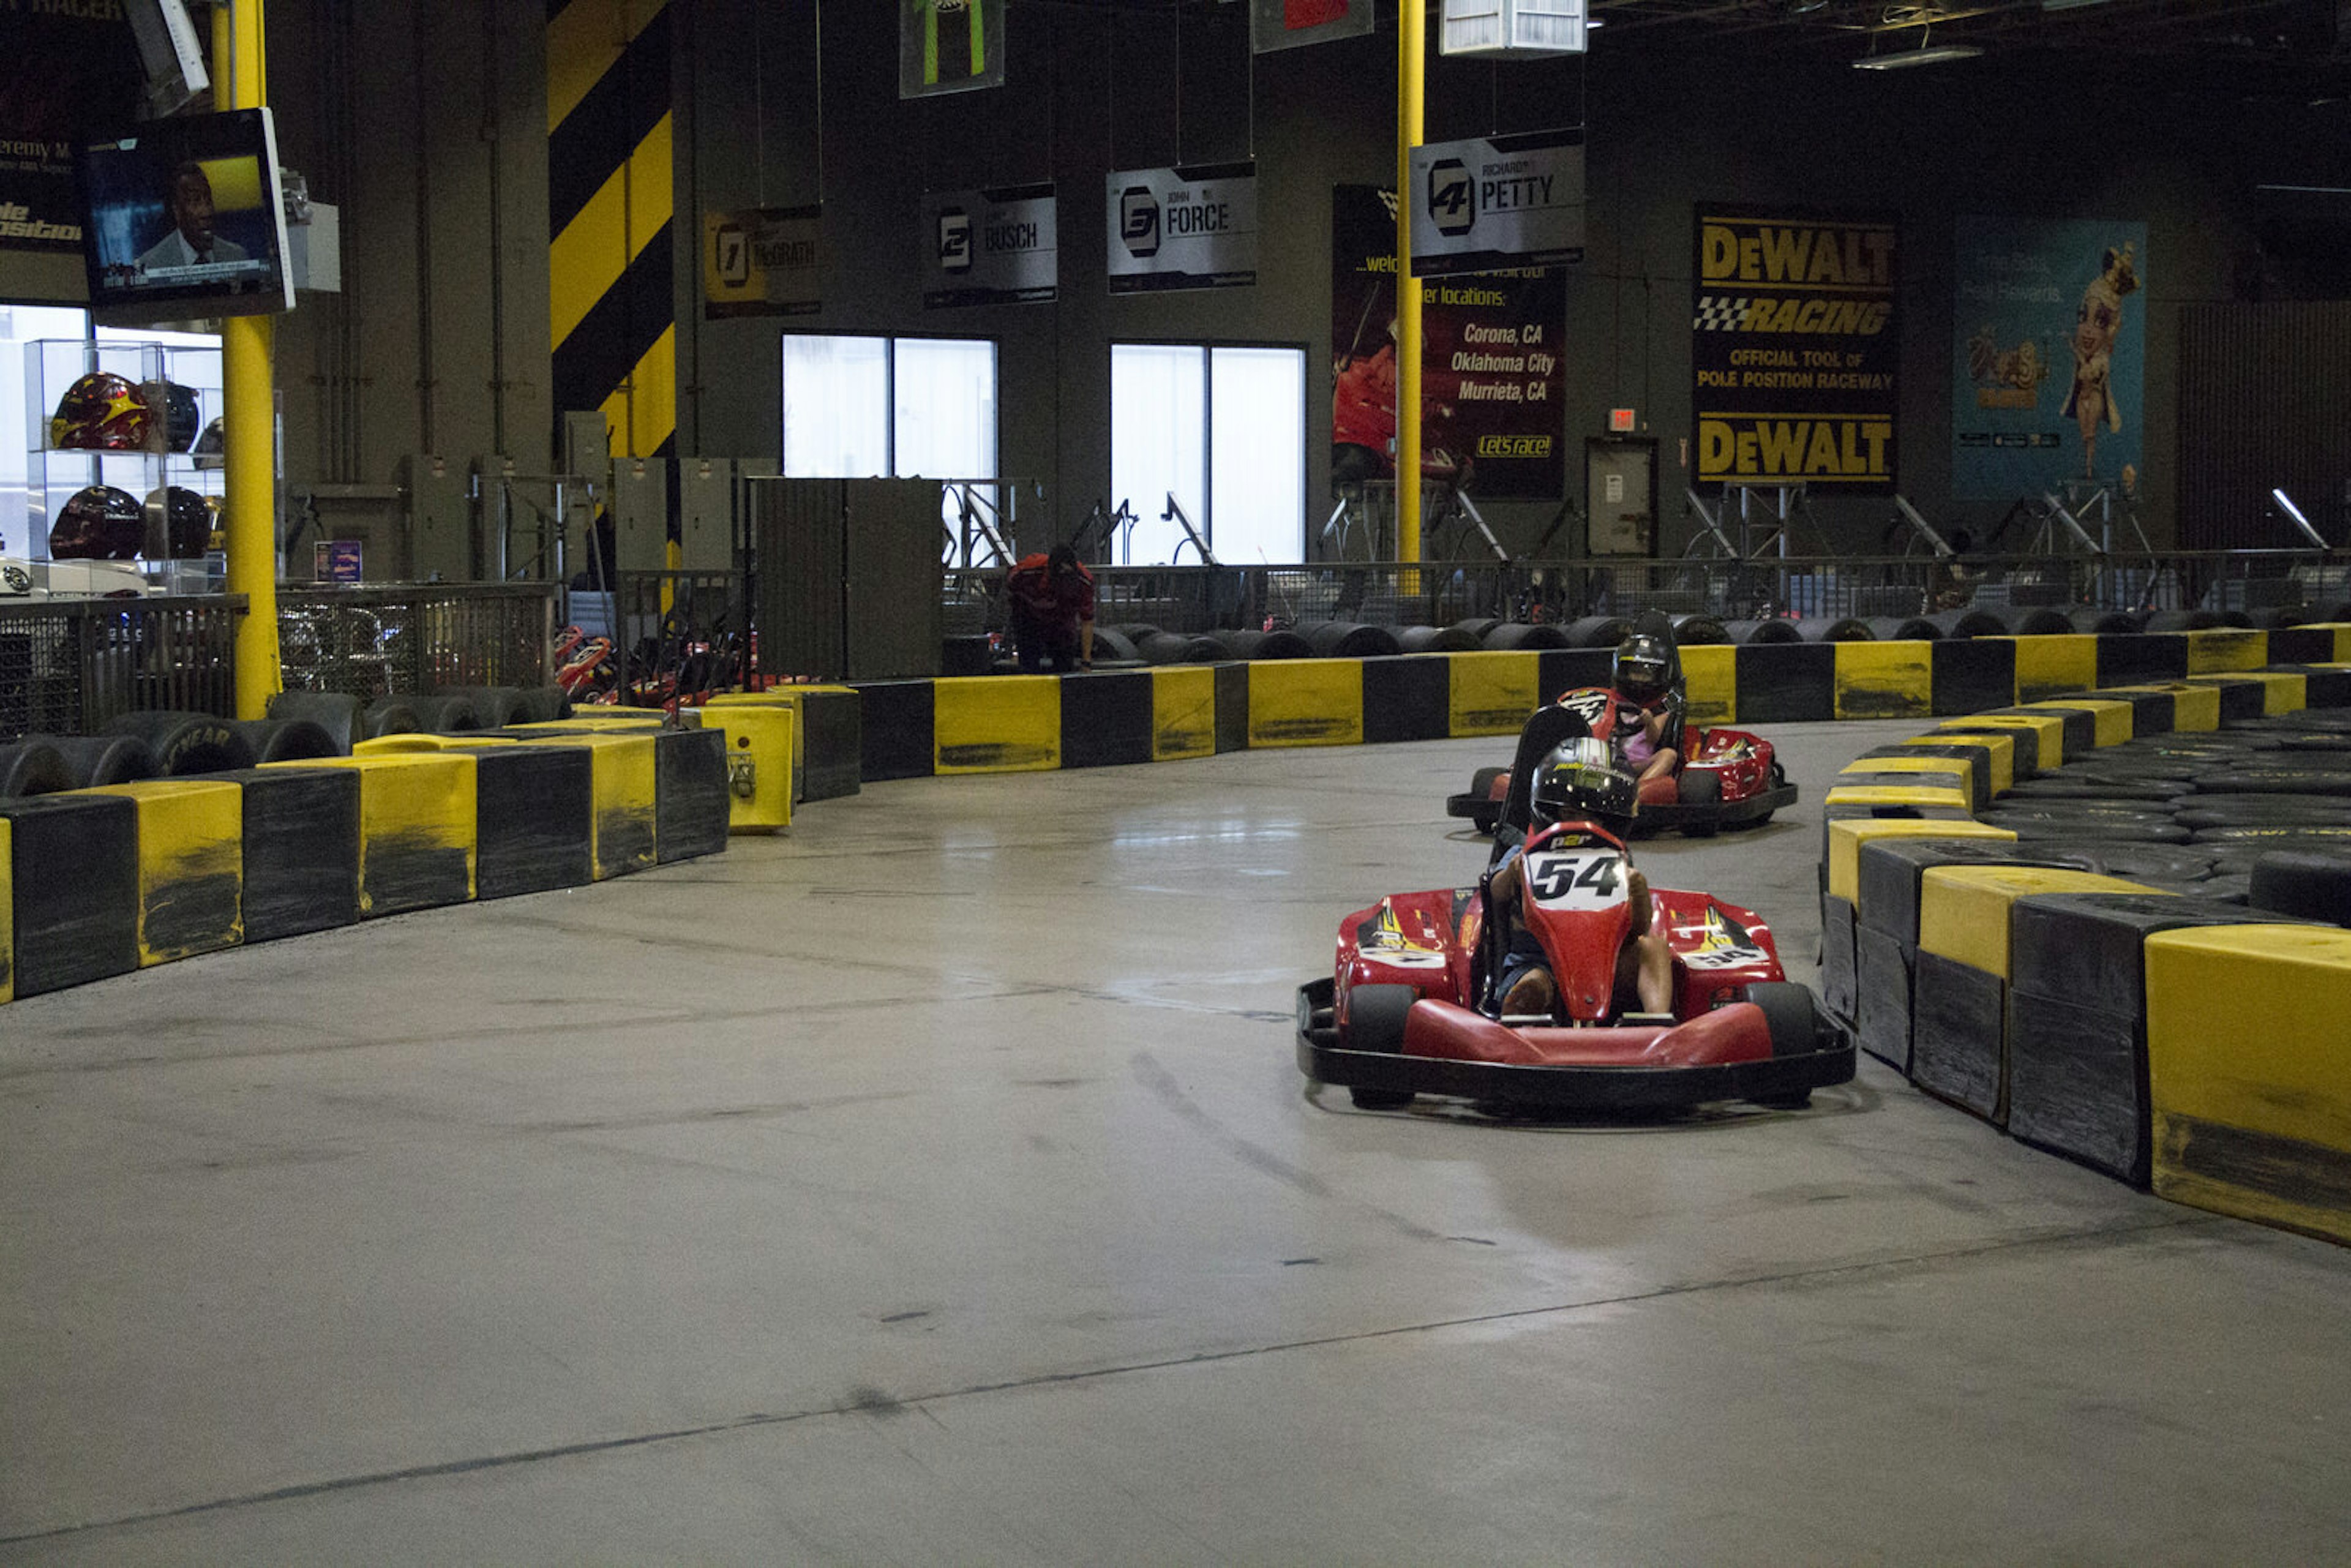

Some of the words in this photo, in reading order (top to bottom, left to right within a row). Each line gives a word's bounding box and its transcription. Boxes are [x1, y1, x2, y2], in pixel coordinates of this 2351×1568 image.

[1482, 174, 1554, 209] PETTY
[1168, 204, 1229, 234] FORCE
[984, 222, 1037, 251] BUSCH
[1441, 285, 1505, 307] locations:
[1739, 298, 1893, 334] RACING
[1464, 322, 1519, 347] Corona,
[1522, 323, 1543, 344] CA
[1451, 351, 1524, 372] Oklahoma
[1528, 353, 1556, 377] City
[1729, 349, 1798, 366] OFFICIAL
[1802, 351, 1842, 367] TOOL
[1846, 353, 1864, 367] OF
[1458, 380, 1524, 405] Murrieta,
[1526, 381, 1548, 401] CA
[1697, 370, 1738, 387] POLE
[1742, 371, 1813, 389] POSITION
[1817, 373, 1894, 390] RACEWAY
[1478, 435, 1513, 455] Let's
[1532, 857, 1620, 901] 54
